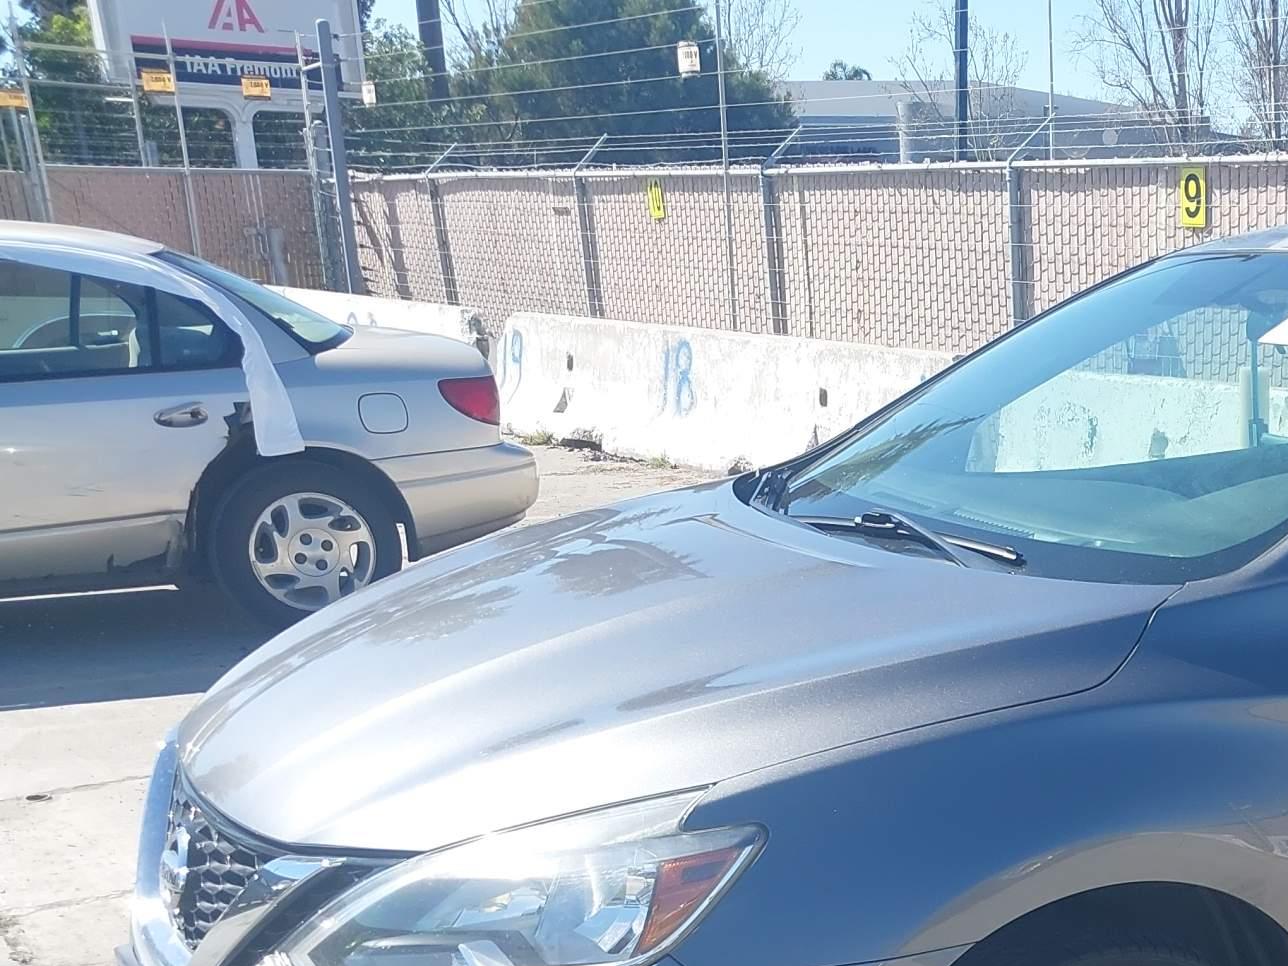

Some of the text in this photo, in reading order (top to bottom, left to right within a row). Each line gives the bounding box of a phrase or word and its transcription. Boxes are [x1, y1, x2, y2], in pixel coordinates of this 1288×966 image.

[184, 54, 222, 75] IAA
[1184, 173, 1202, 218] 9
[655, 338, 697, 416] 18
